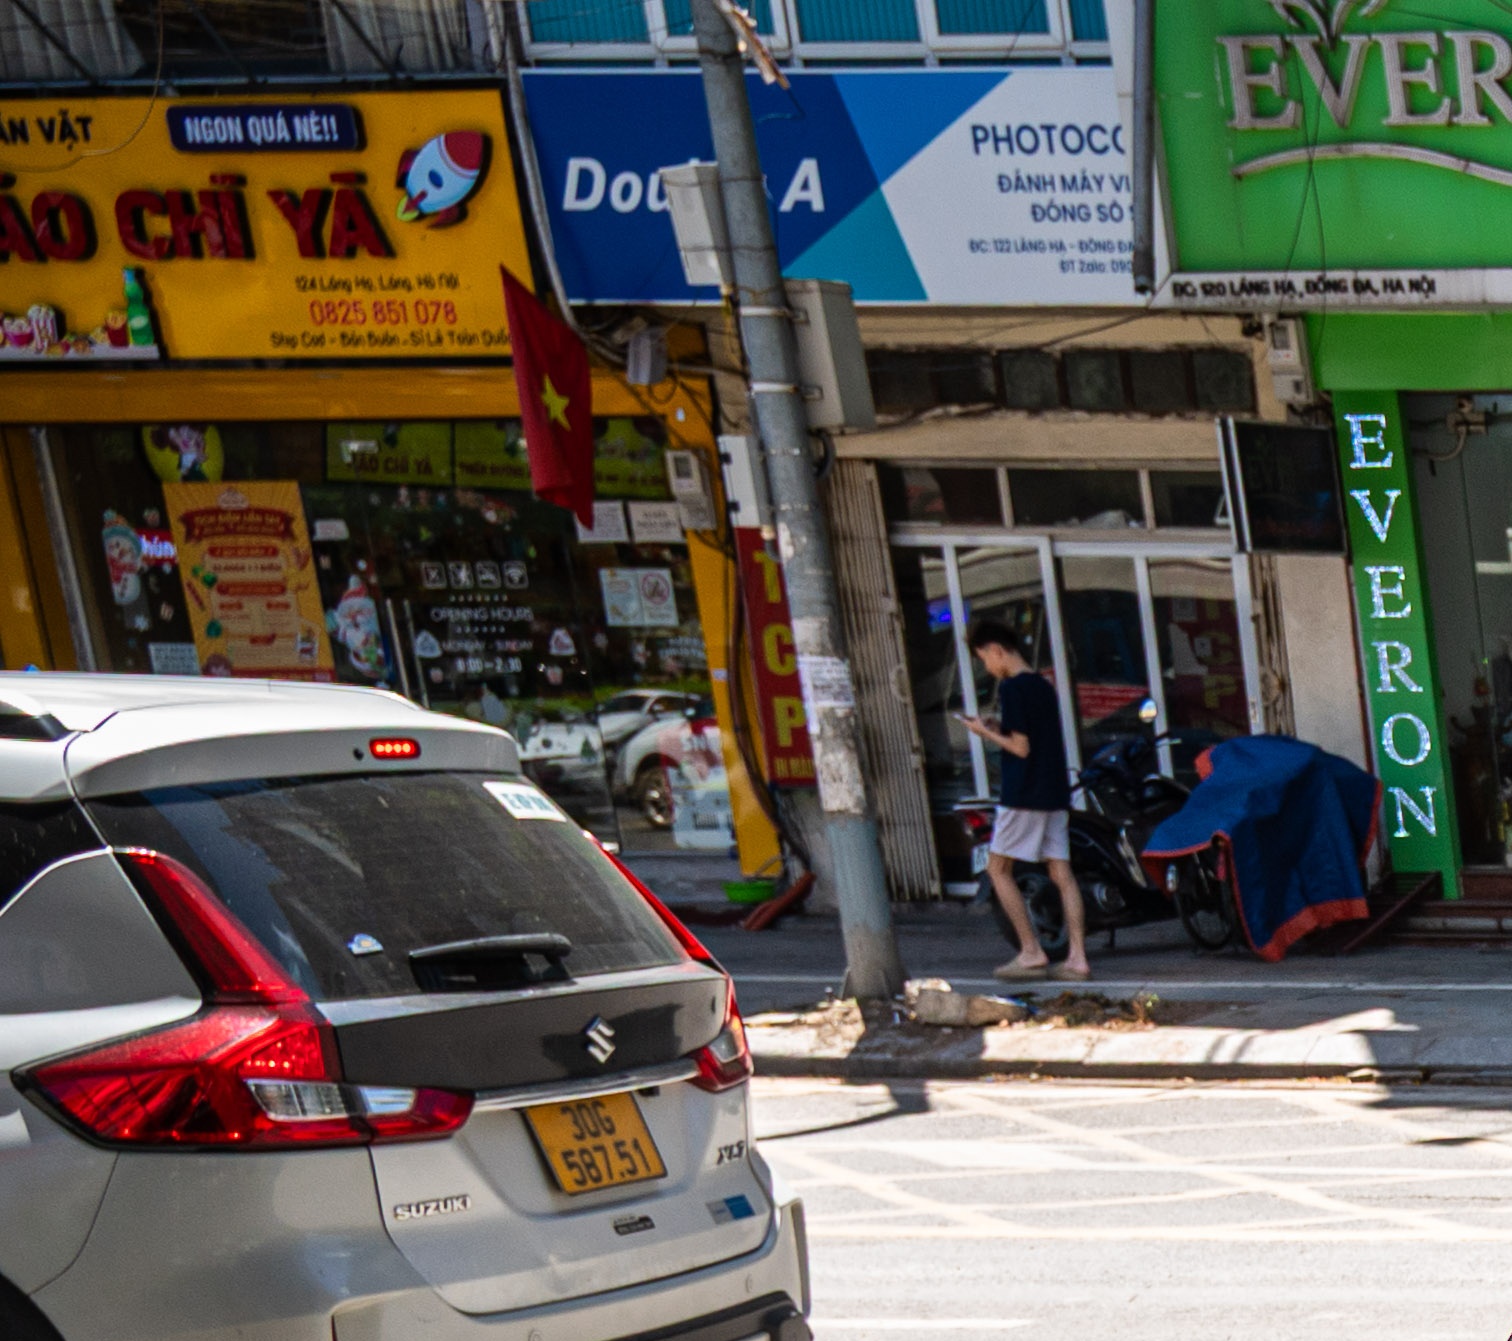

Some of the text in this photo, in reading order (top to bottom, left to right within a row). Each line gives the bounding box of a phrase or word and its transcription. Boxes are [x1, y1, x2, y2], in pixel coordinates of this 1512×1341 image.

[184, 116, 243, 144] NGON
[246, 112, 291, 144] QUÁ
[997, 169, 1056, 193] ĐÁNH
[1060, 169, 1105, 193] MÁY
[1031, 201, 1092, 223] ĐÓNG
[310, 299, 458, 327] 0825 851 078
[1343, 412, 1437, 838] EVERON
[561, 1099, 617, 1142] 30G
[560, 1136, 652, 1188] 587.51
[393, 1194, 473, 1221] SUZUKI
